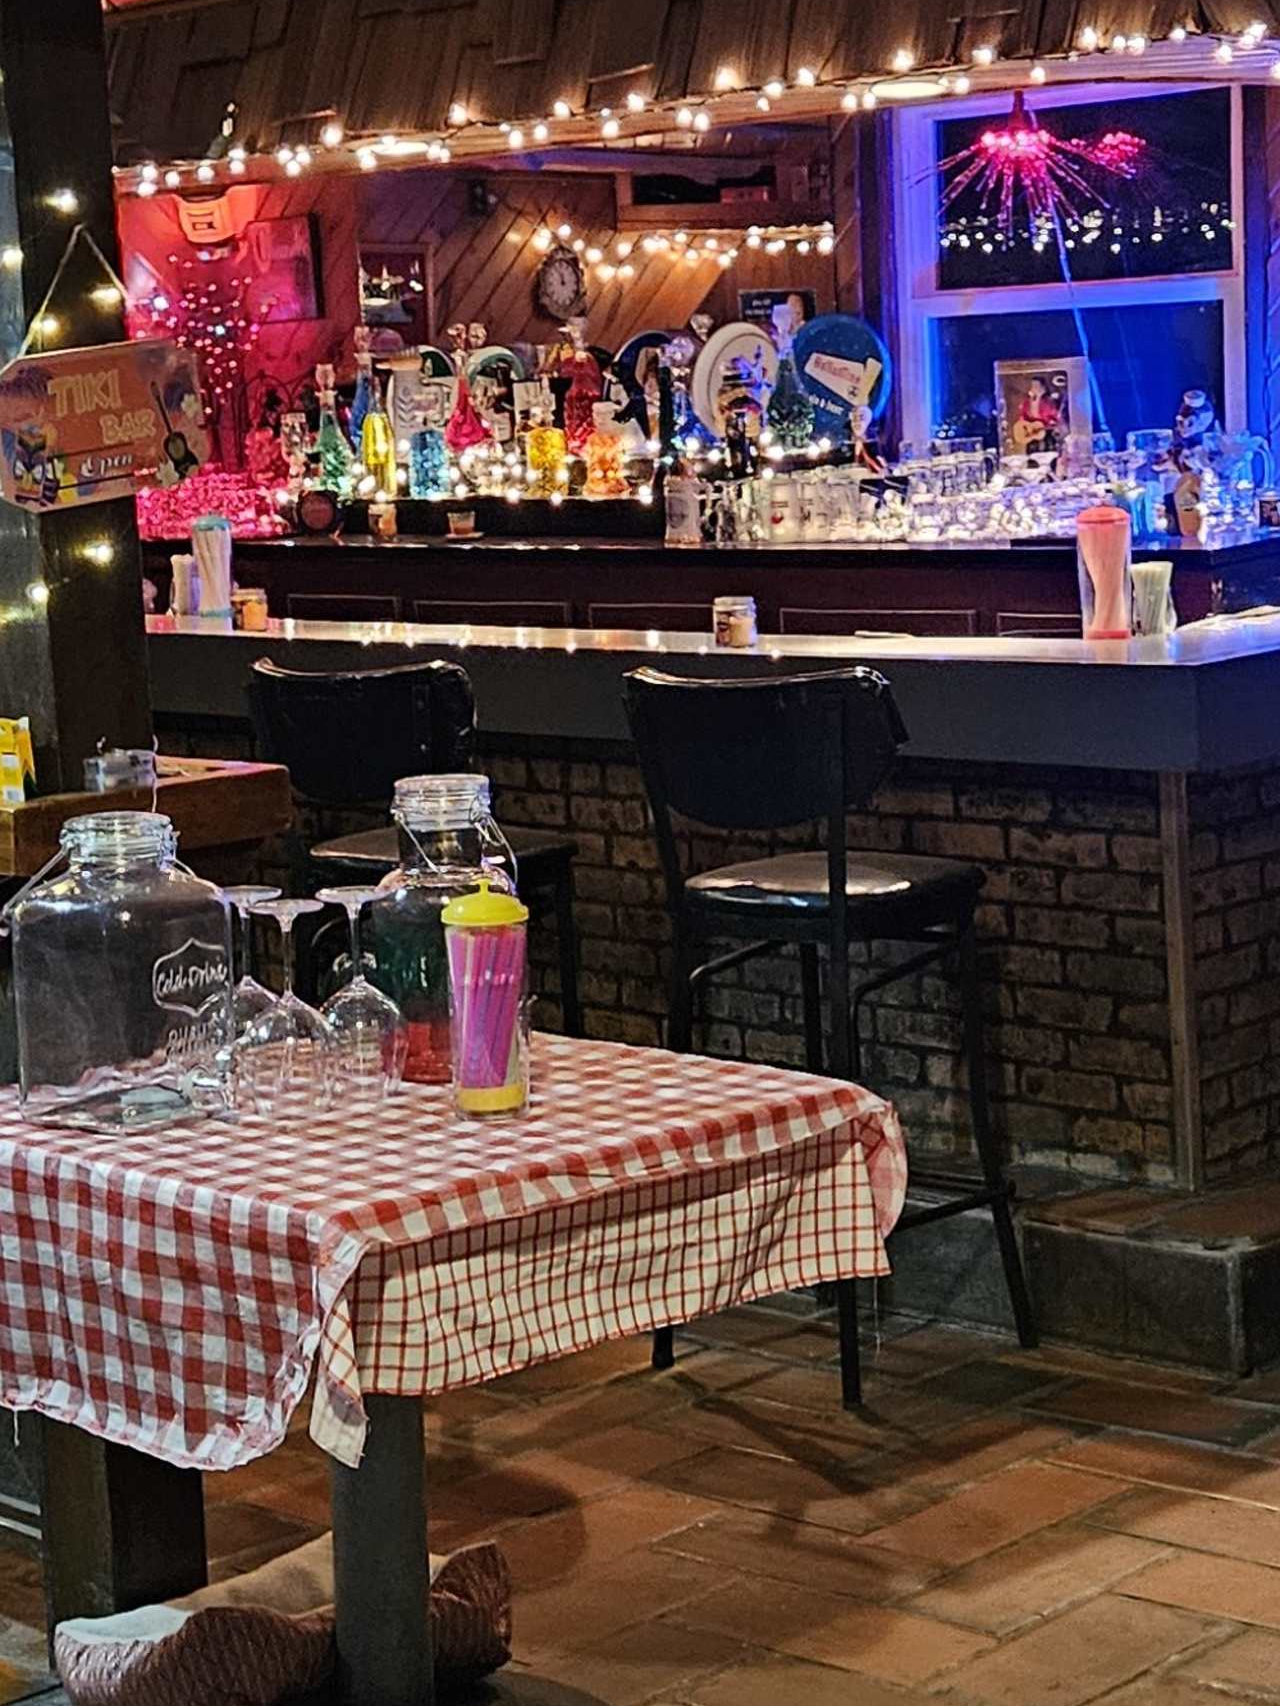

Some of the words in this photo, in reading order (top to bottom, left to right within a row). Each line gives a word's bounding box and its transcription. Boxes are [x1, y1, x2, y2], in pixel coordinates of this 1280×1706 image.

[47, 369, 122, 418] TIKI
[100, 408, 157, 445] BAR
[81, 454, 133, 477] Open
